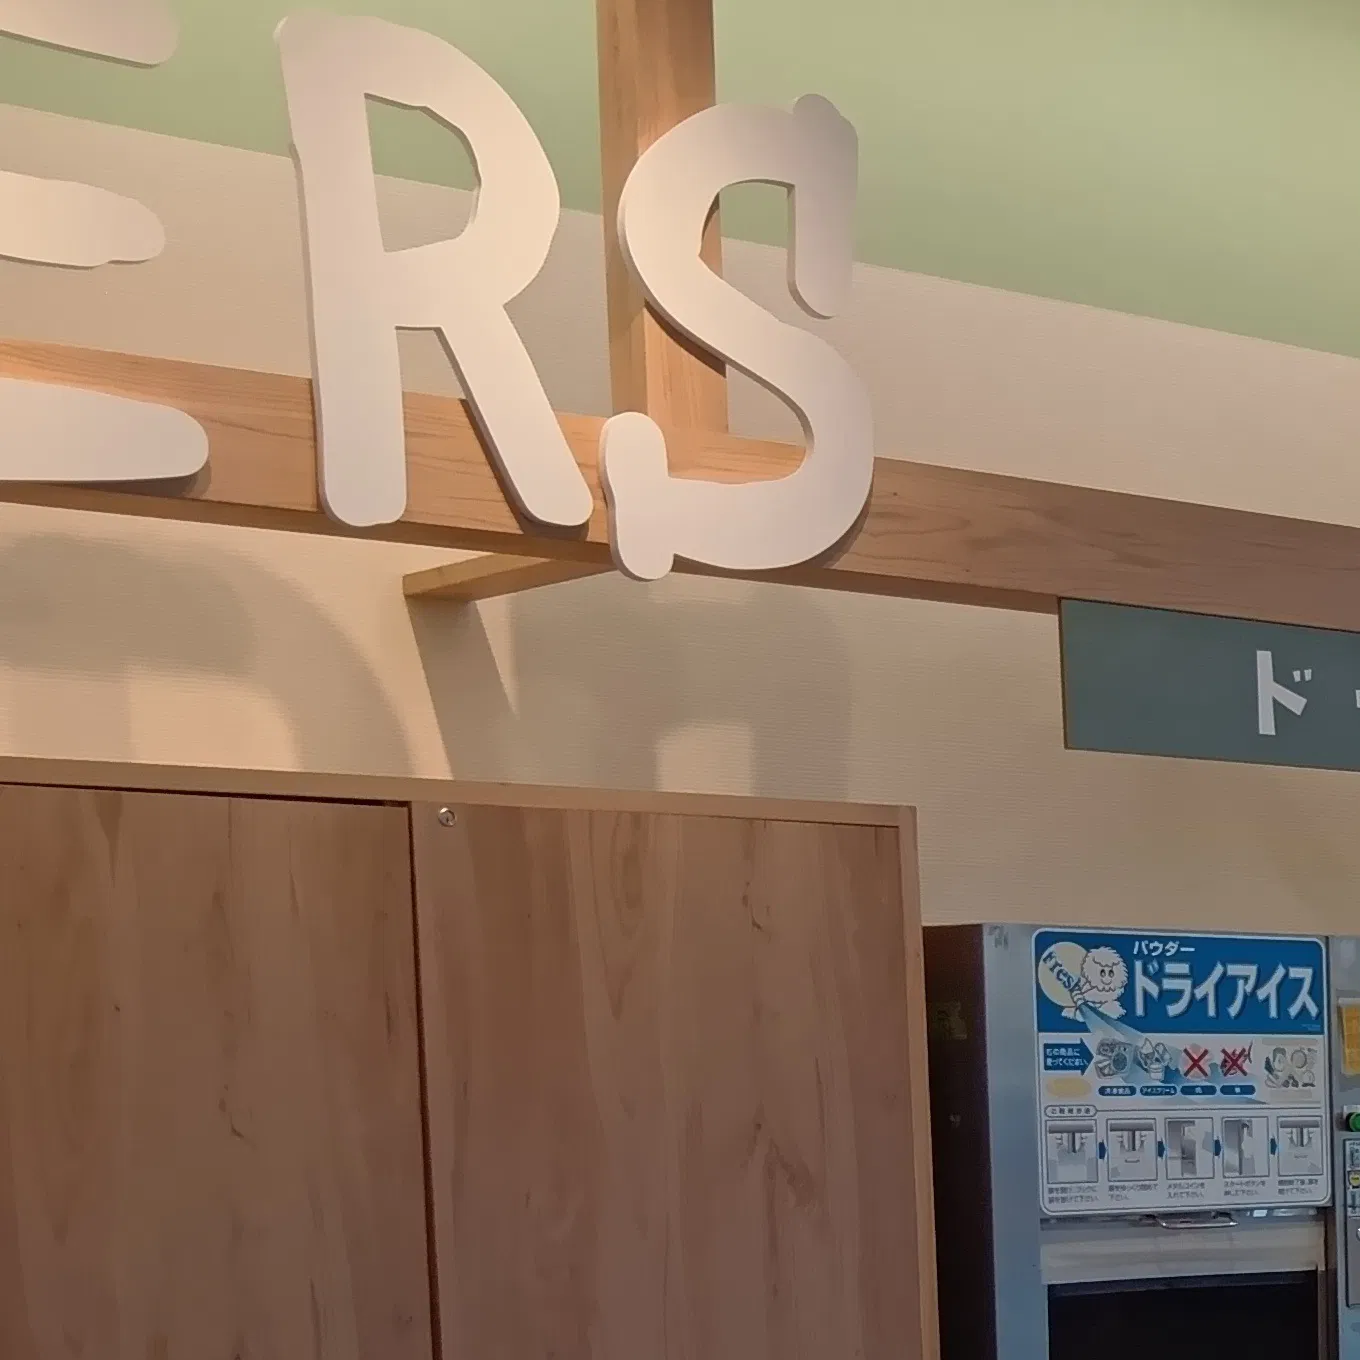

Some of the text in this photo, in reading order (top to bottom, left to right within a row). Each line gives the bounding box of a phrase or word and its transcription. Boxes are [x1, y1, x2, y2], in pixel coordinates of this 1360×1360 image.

[1133, 941, 1195, 956] パウダー
[1134, 960, 1320, 1020] ドライアイス
